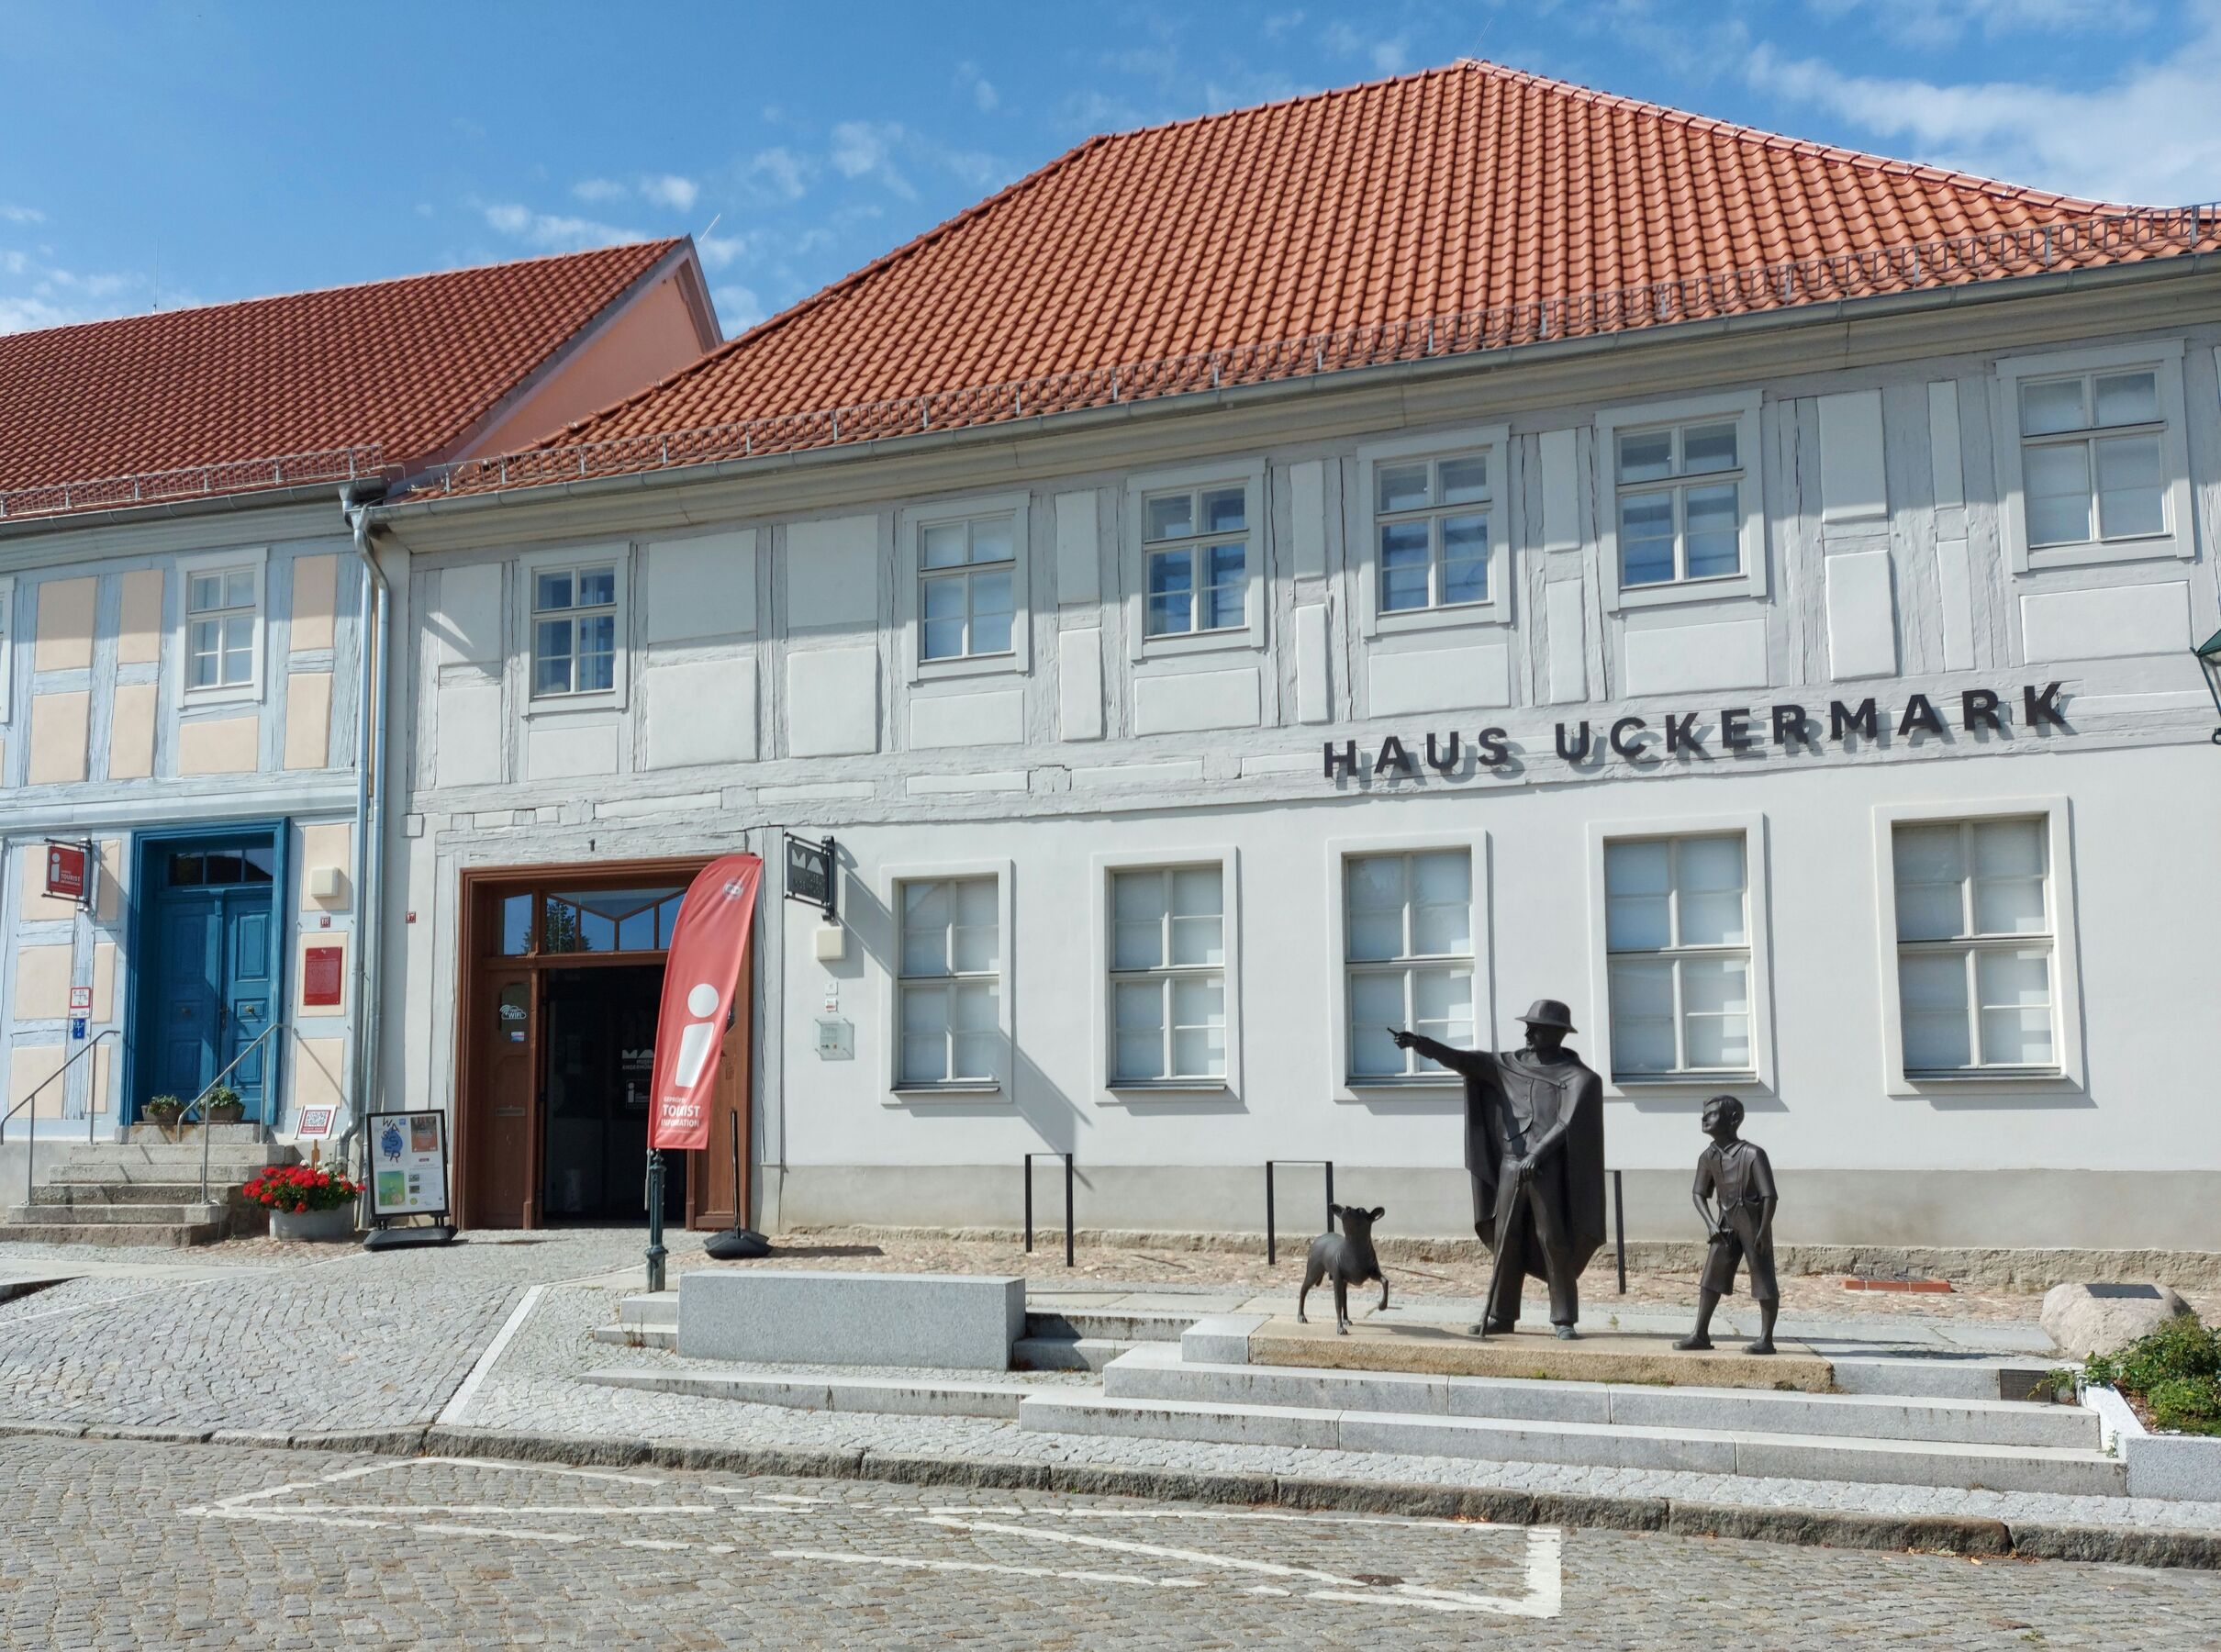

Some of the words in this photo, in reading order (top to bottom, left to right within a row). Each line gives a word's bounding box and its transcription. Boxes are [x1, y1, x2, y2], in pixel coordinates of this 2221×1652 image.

[1324, 727, 1511, 779] HAUS
[1555, 681, 2066, 763] UCKERMARK
[61, 874, 80, 882] TOURIST
